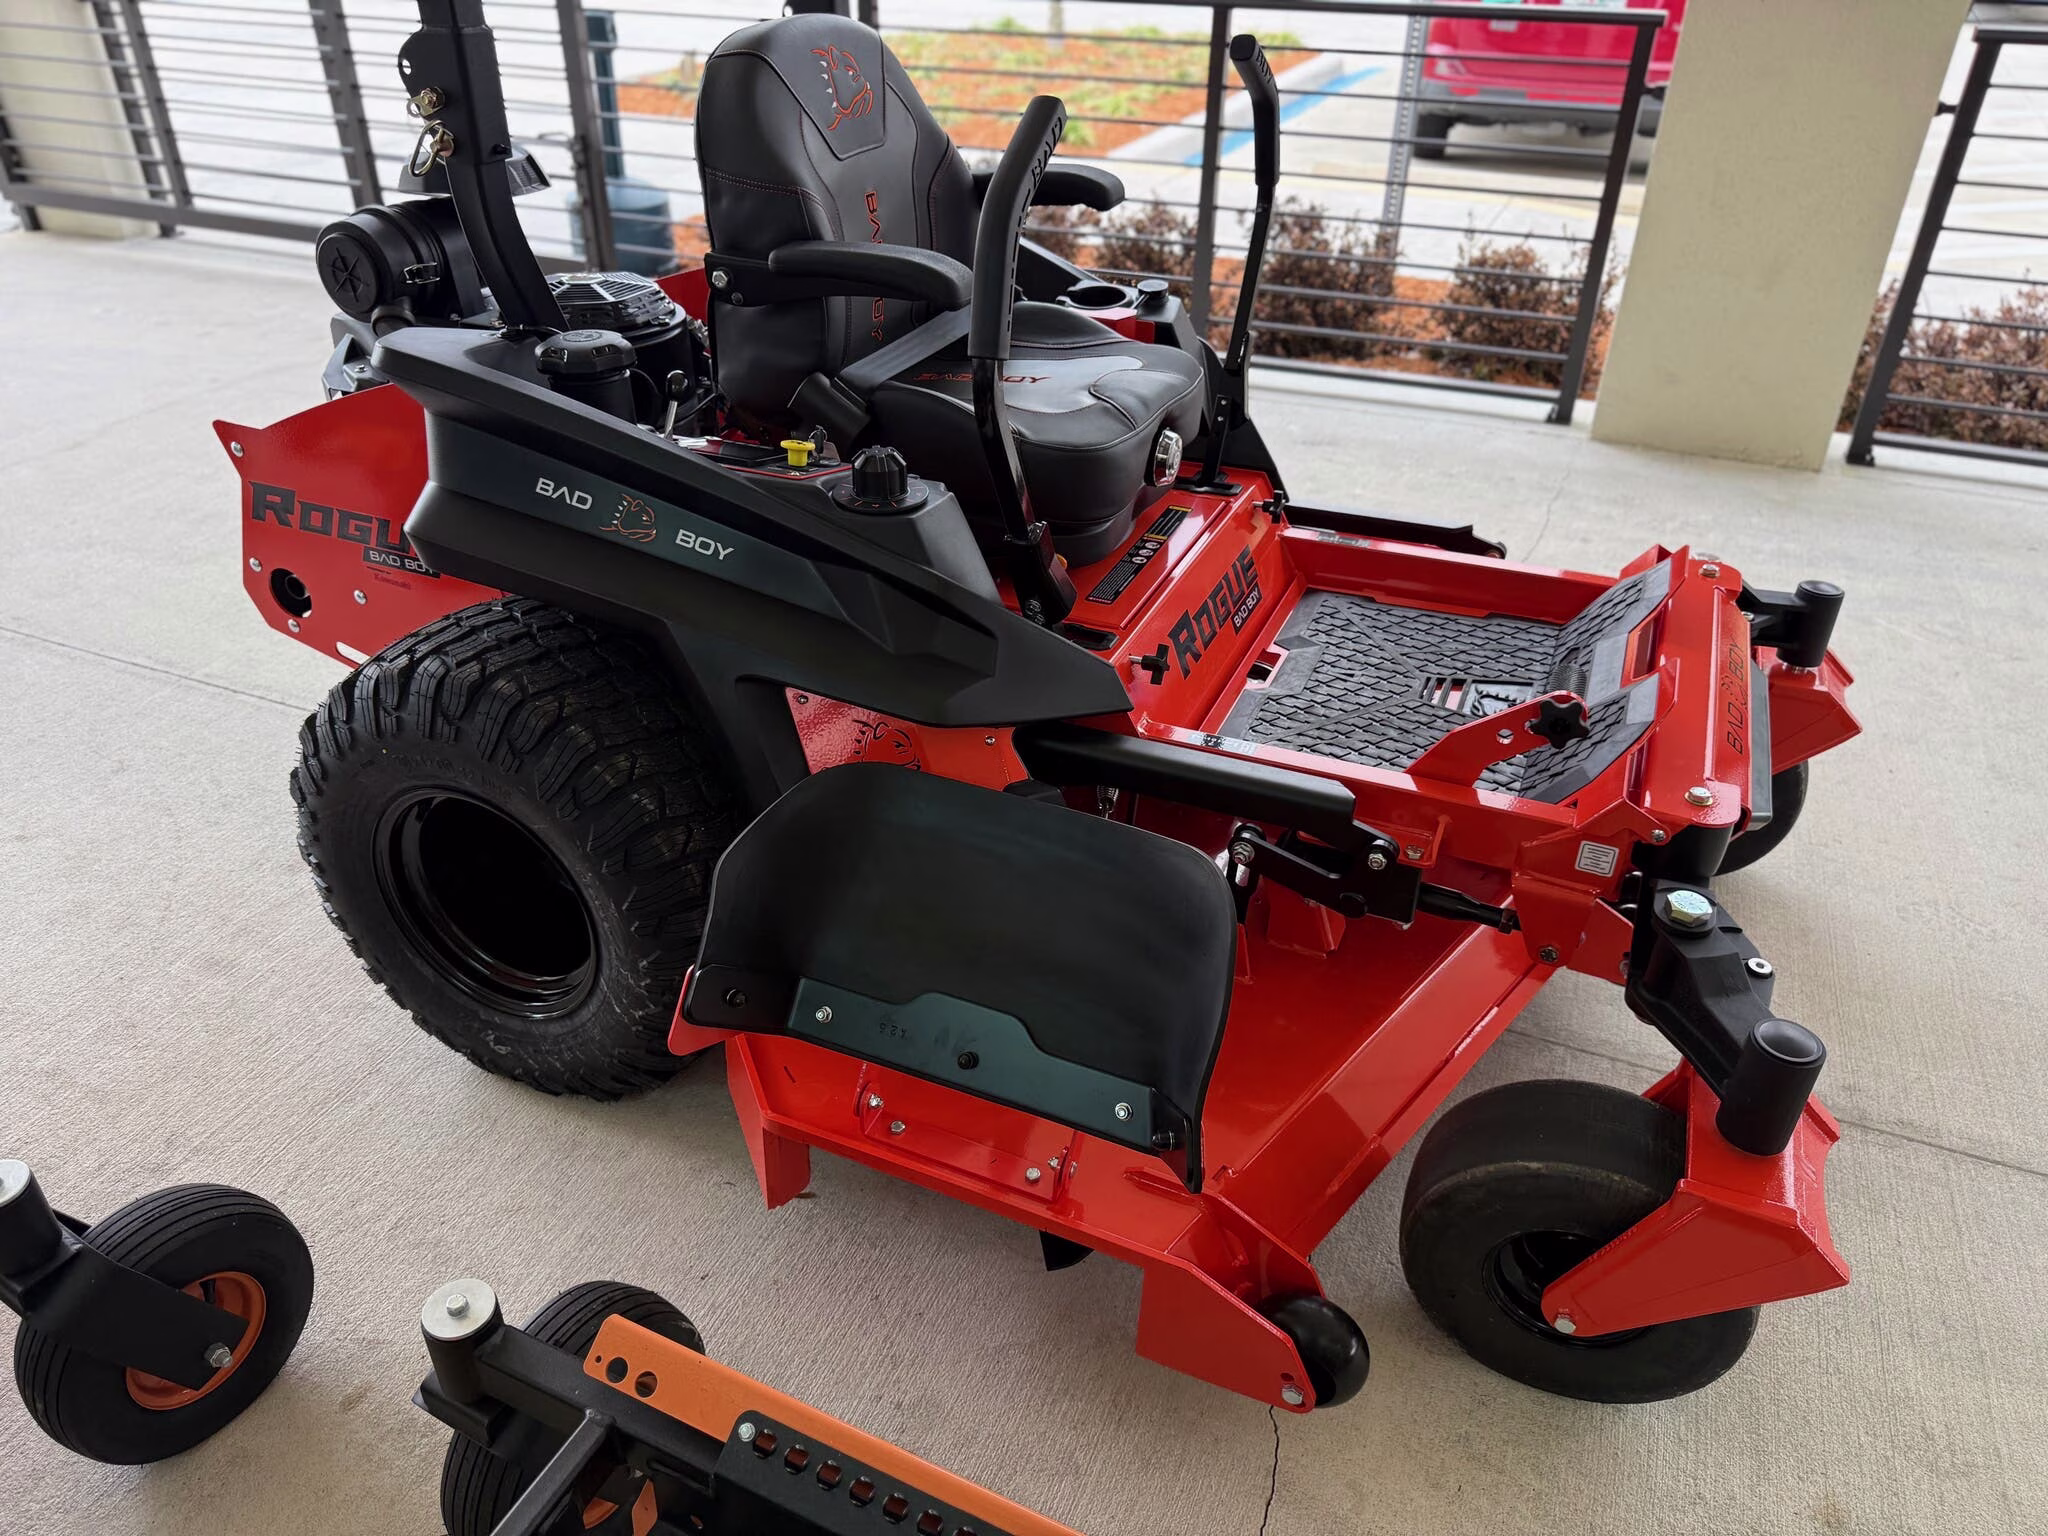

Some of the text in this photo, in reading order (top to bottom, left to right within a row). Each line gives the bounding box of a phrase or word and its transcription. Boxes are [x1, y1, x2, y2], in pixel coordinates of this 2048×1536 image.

[864, 191, 884, 341] BA OY
[1002, 375, 1052, 384] OY
[247, 481, 412, 554] ROGU
[536, 477, 735, 561] BAD BOY
[369, 550, 401, 566] BAD
[1167, 543, 1259, 681] ROGUE
[1233, 587, 1260, 628] BAD BOY
[1727, 633, 1745, 755] BAD BOY
